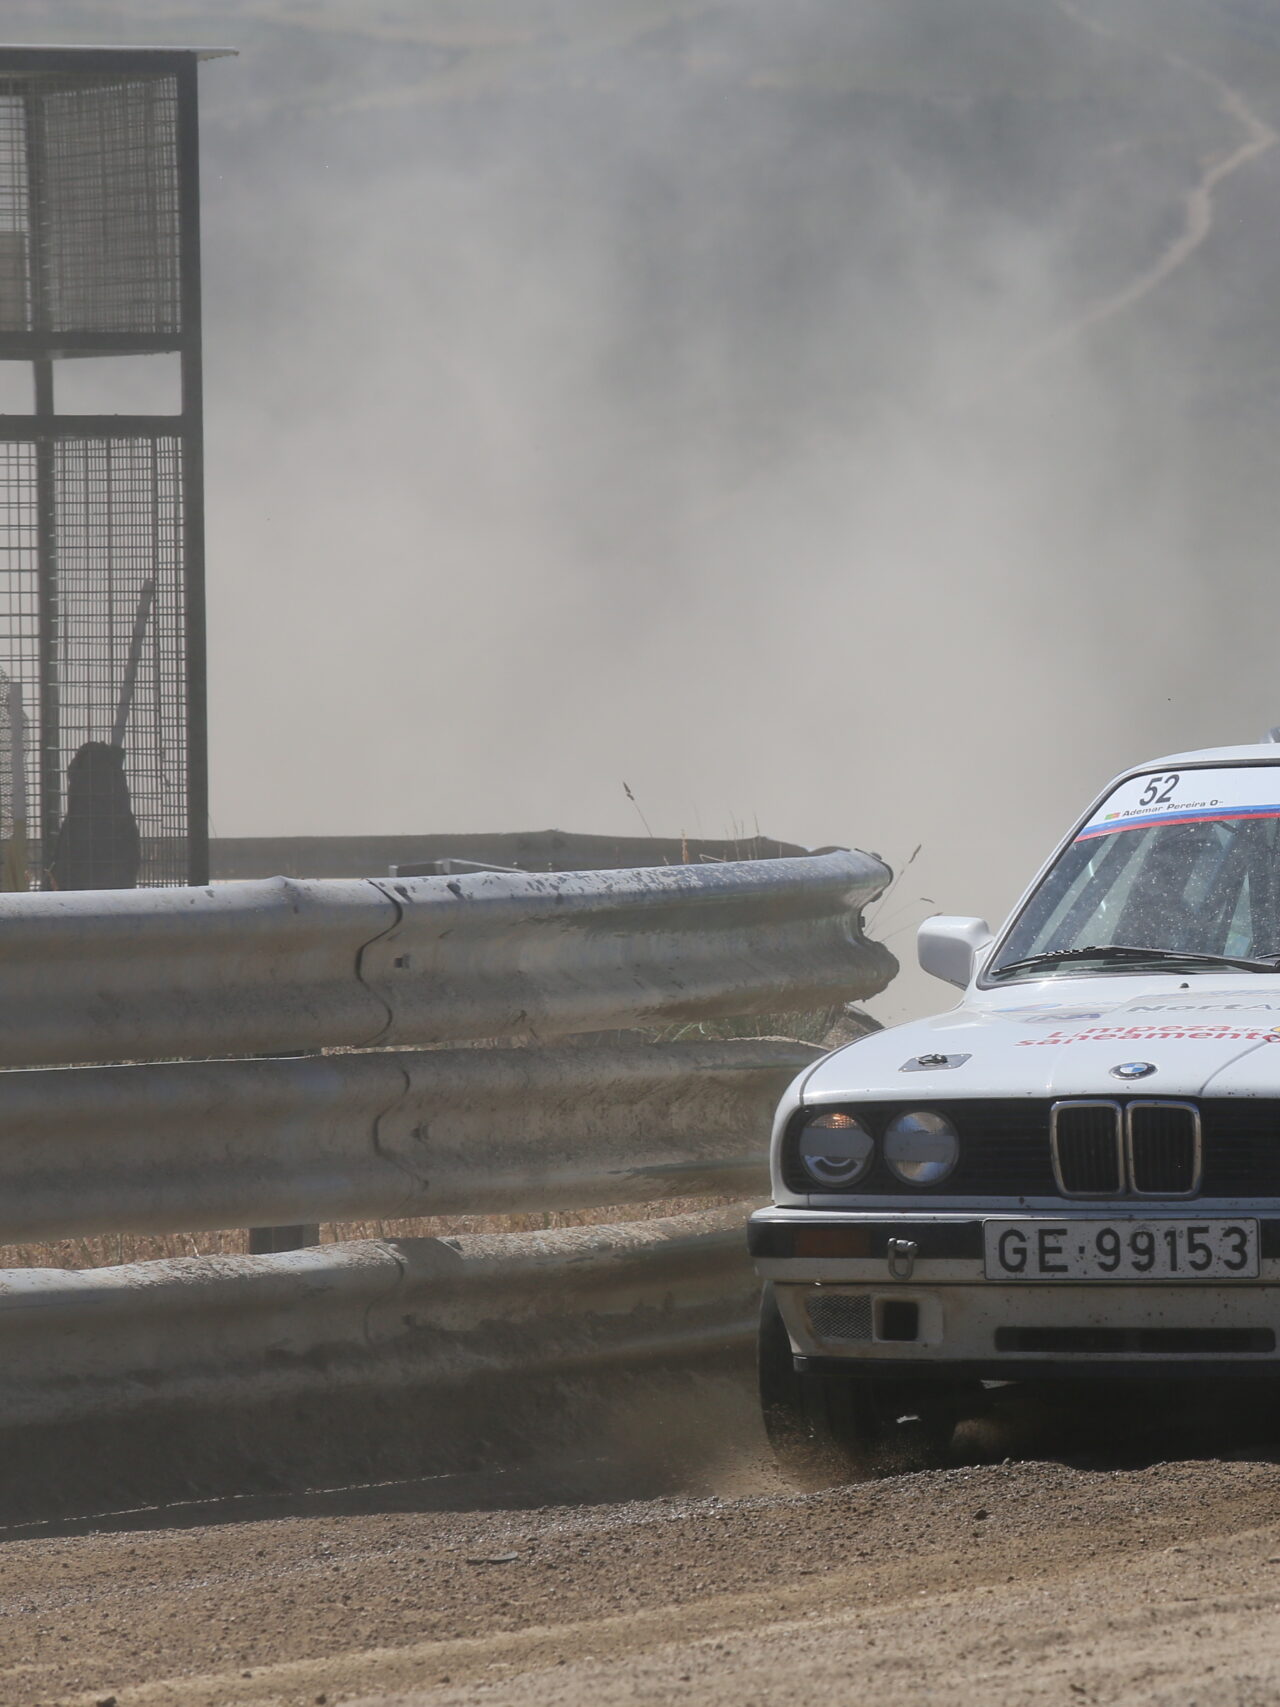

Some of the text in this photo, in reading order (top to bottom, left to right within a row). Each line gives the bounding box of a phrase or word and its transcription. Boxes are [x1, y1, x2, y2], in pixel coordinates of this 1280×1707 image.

[1139, 774, 1180, 806] 52
[1122, 806, 1163, 817] Ademar
[1166, 801, 1206, 810] Pereira
[1048, 1024, 1232, 1039] Limpeza
